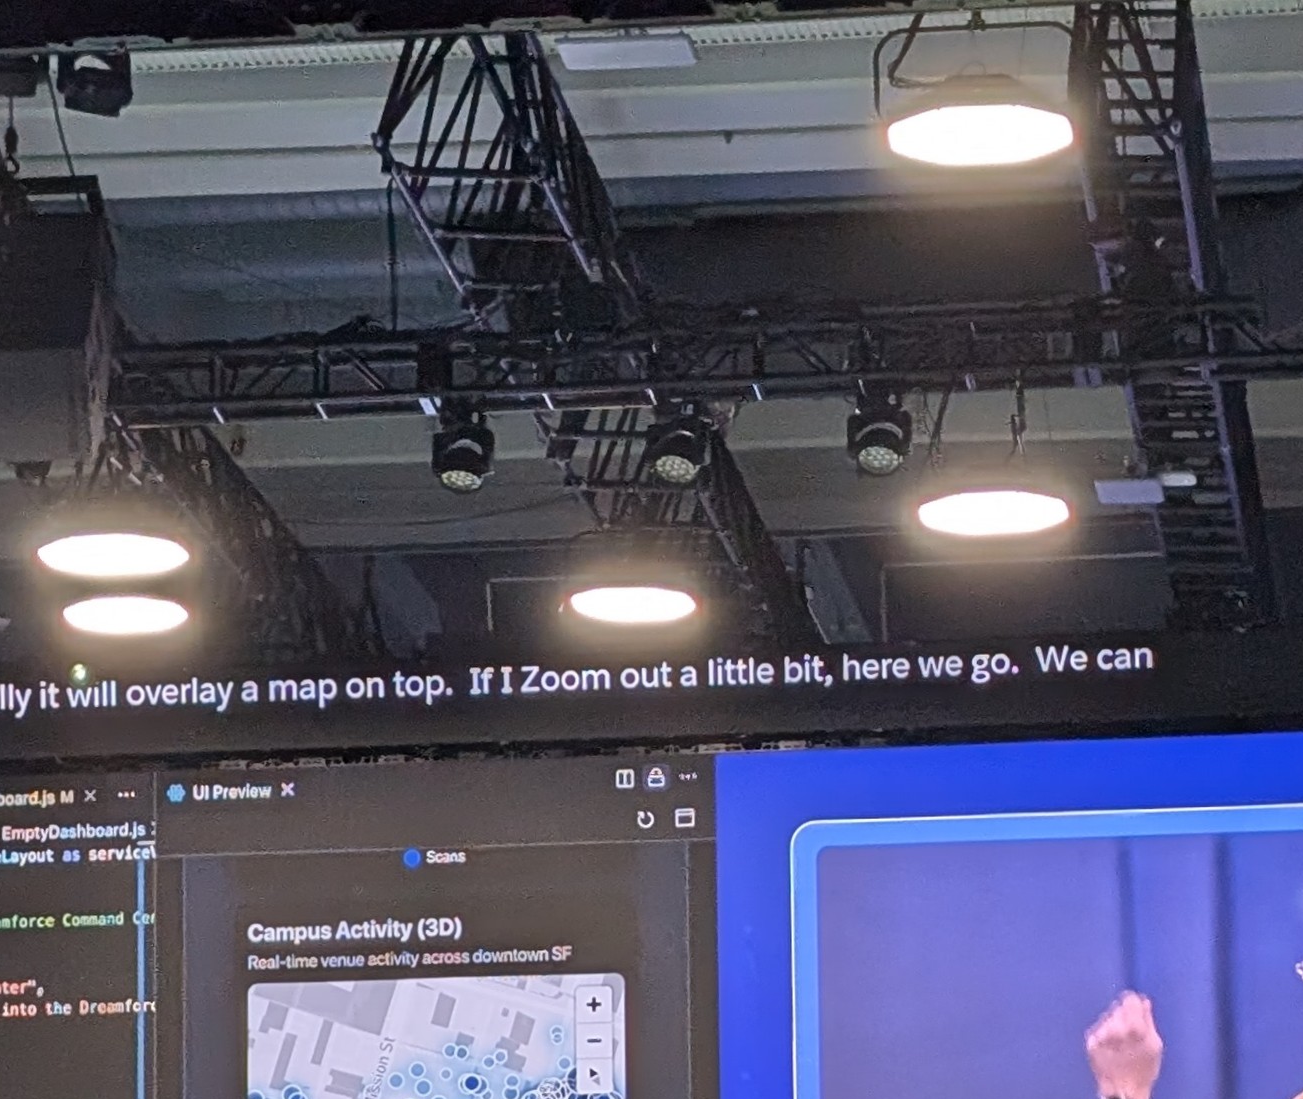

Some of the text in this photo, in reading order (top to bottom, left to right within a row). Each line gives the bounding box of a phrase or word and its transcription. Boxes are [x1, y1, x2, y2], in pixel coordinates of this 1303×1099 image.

[39, 680, 60, 709] it
[66, 680, 116, 707] will
[126, 678, 234, 711] overlay
[240, 680, 258, 702] a
[268, 678, 337, 707] map
[345, 677, 384, 699] on
[392, 671, 453, 703] top.
[469, 667, 494, 695] If
[500, 666, 513, 694] I
[520, 665, 611, 693] Zoom
[620, 661, 672, 689] out
[680, 665, 698, 687] a
[708, 657, 774, 685] little
[784, 654, 833, 686] bit,
[842, 654, 910, 680] here
[918, 655, 963, 677] we
[970, 653, 1019, 683] go.
[1034, 645, 1088, 672] We
[1096, 647, 1153, 670] can
[60, 789, 74, 803] M
[192, 783, 272, 800] UI Preview
[2, 822, 145, 843] EmptyDashboard.js
[426, 850, 466, 863] Scans
[62, 911, 124, 927] Command
[247, 917, 462, 944] Campus Activity (3D)
[247, 945, 572, 969] Real-time venue activity across downtown SF
